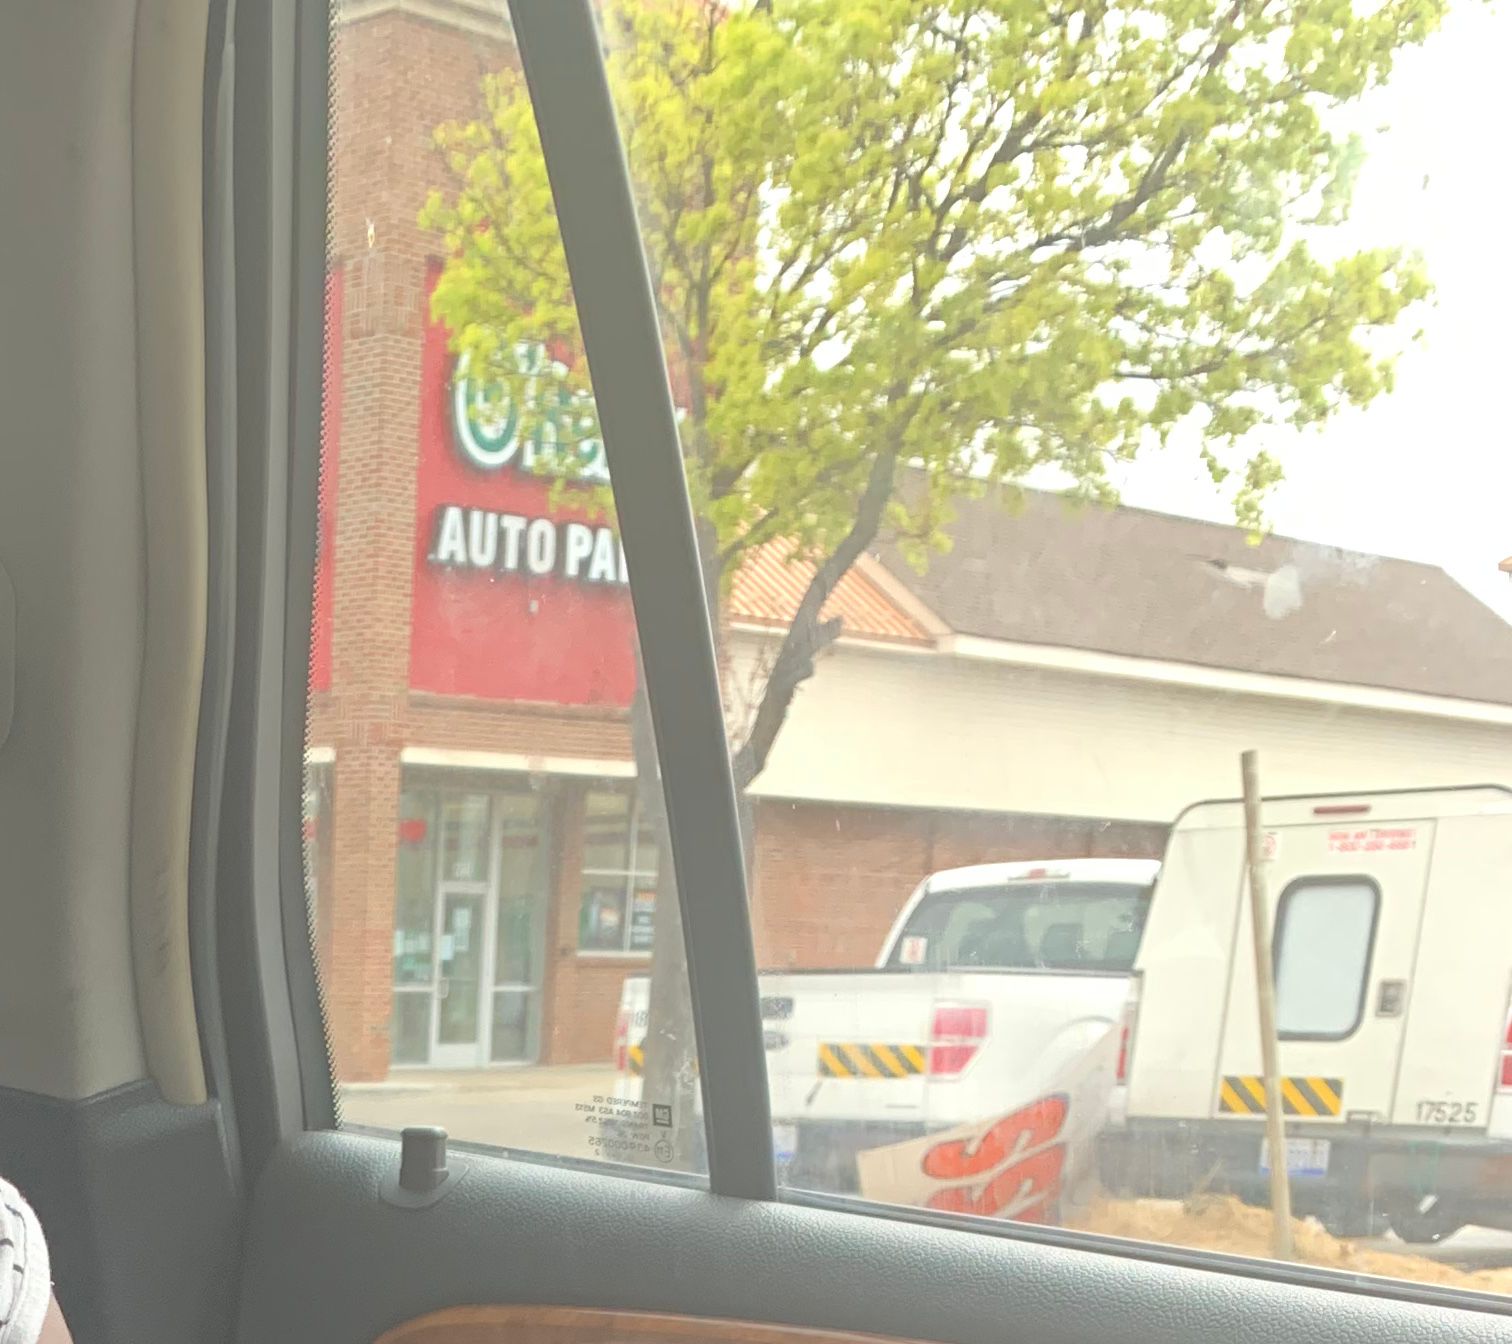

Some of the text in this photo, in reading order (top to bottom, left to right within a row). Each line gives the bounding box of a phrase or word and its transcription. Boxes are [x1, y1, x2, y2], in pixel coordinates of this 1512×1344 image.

[437, 506, 629, 584] AUTO PA
[1415, 1102, 1478, 1123] 17525
